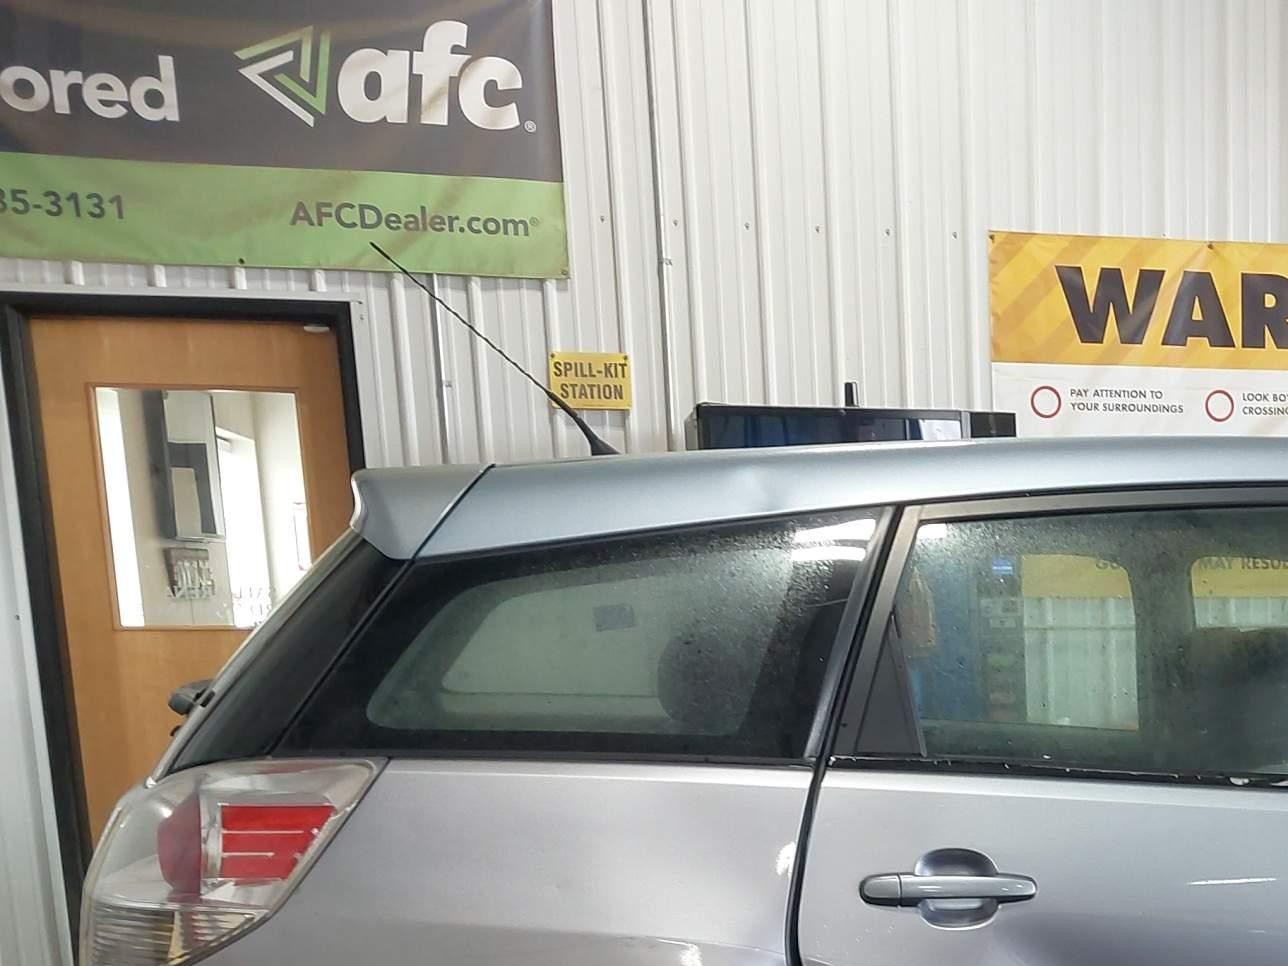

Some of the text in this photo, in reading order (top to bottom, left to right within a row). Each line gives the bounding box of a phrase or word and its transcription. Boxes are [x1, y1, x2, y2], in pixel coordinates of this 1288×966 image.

[553, 361, 628, 378] SPILL-KIT
[560, 383, 624, 400] STATION
[1070, 388, 1163, 399] PAY ATTENTION TO
[1242, 392, 1270, 402] LOOK
[1070, 402, 1184, 413] YOUR SURROUNDINGS
